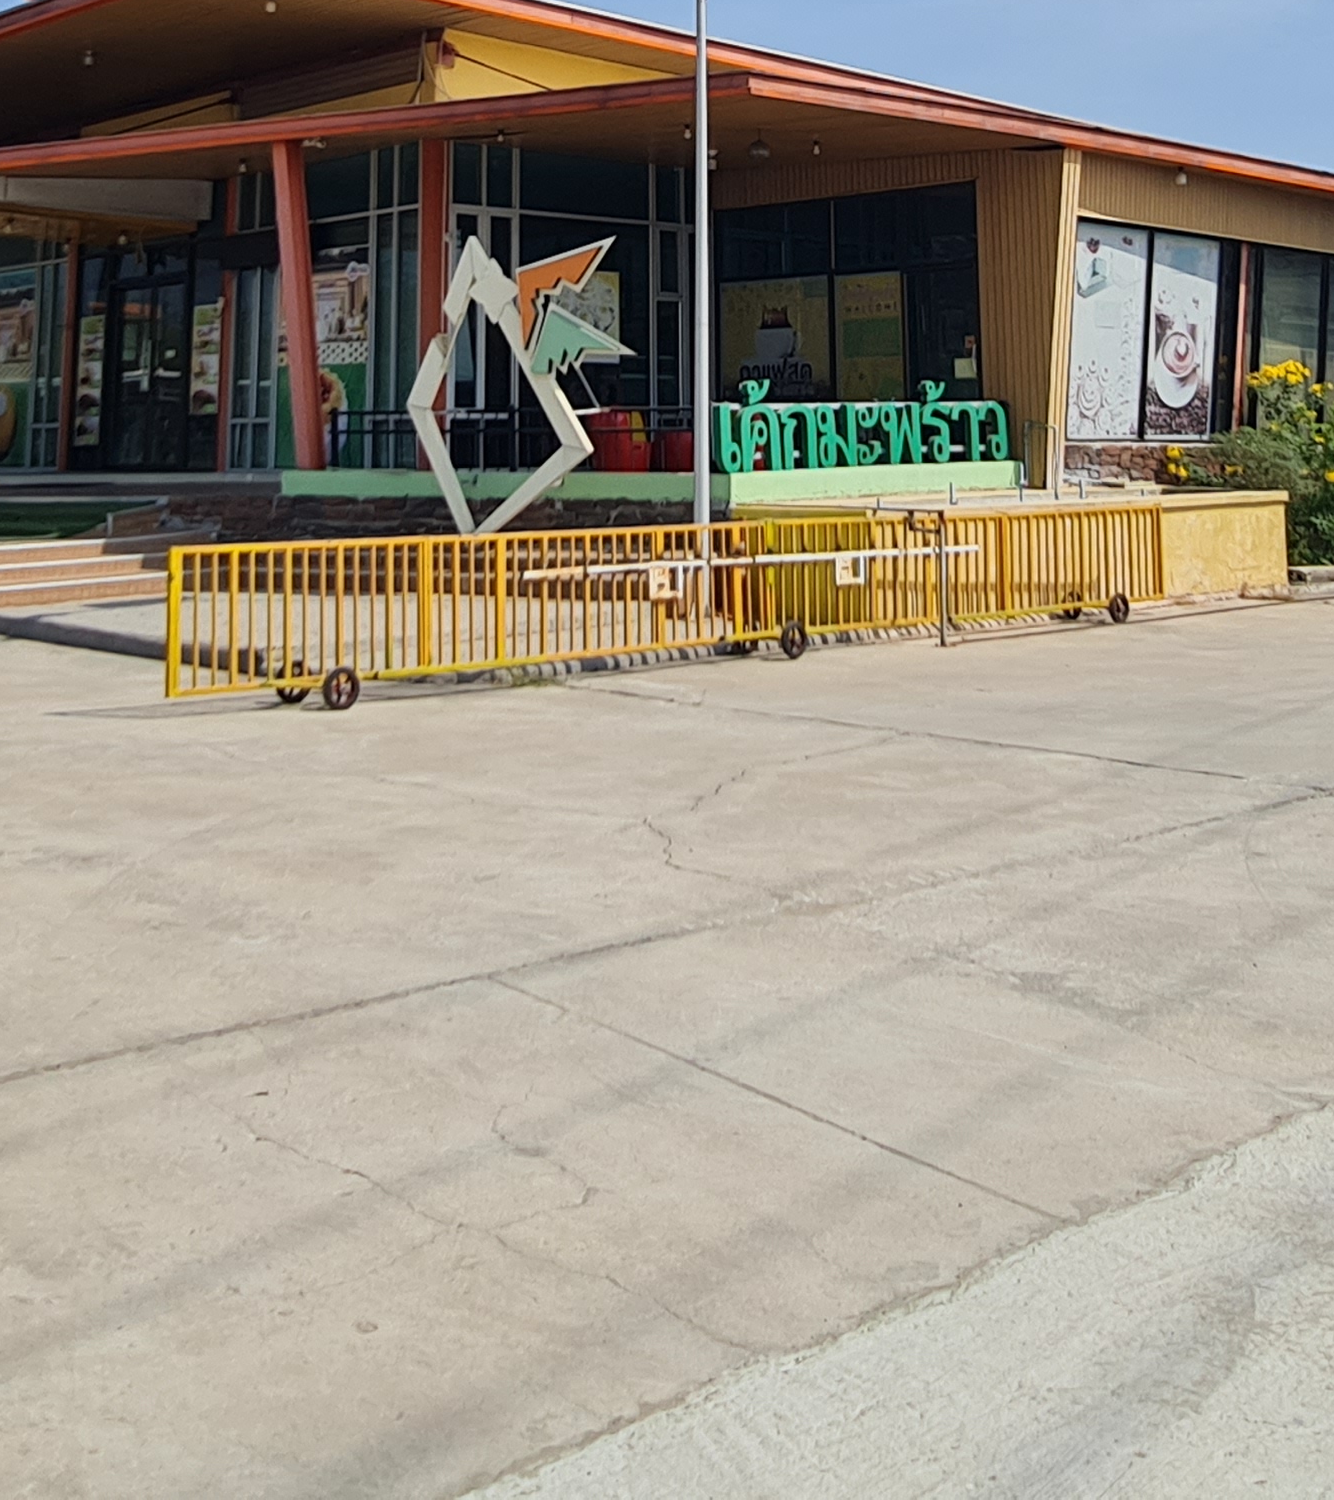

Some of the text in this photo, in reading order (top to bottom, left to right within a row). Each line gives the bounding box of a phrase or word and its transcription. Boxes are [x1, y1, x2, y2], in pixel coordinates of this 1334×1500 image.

[740, 357, 813, 381] กาแฟสด
[714, 378, 1010, 474] เค้กมะพร้าว
